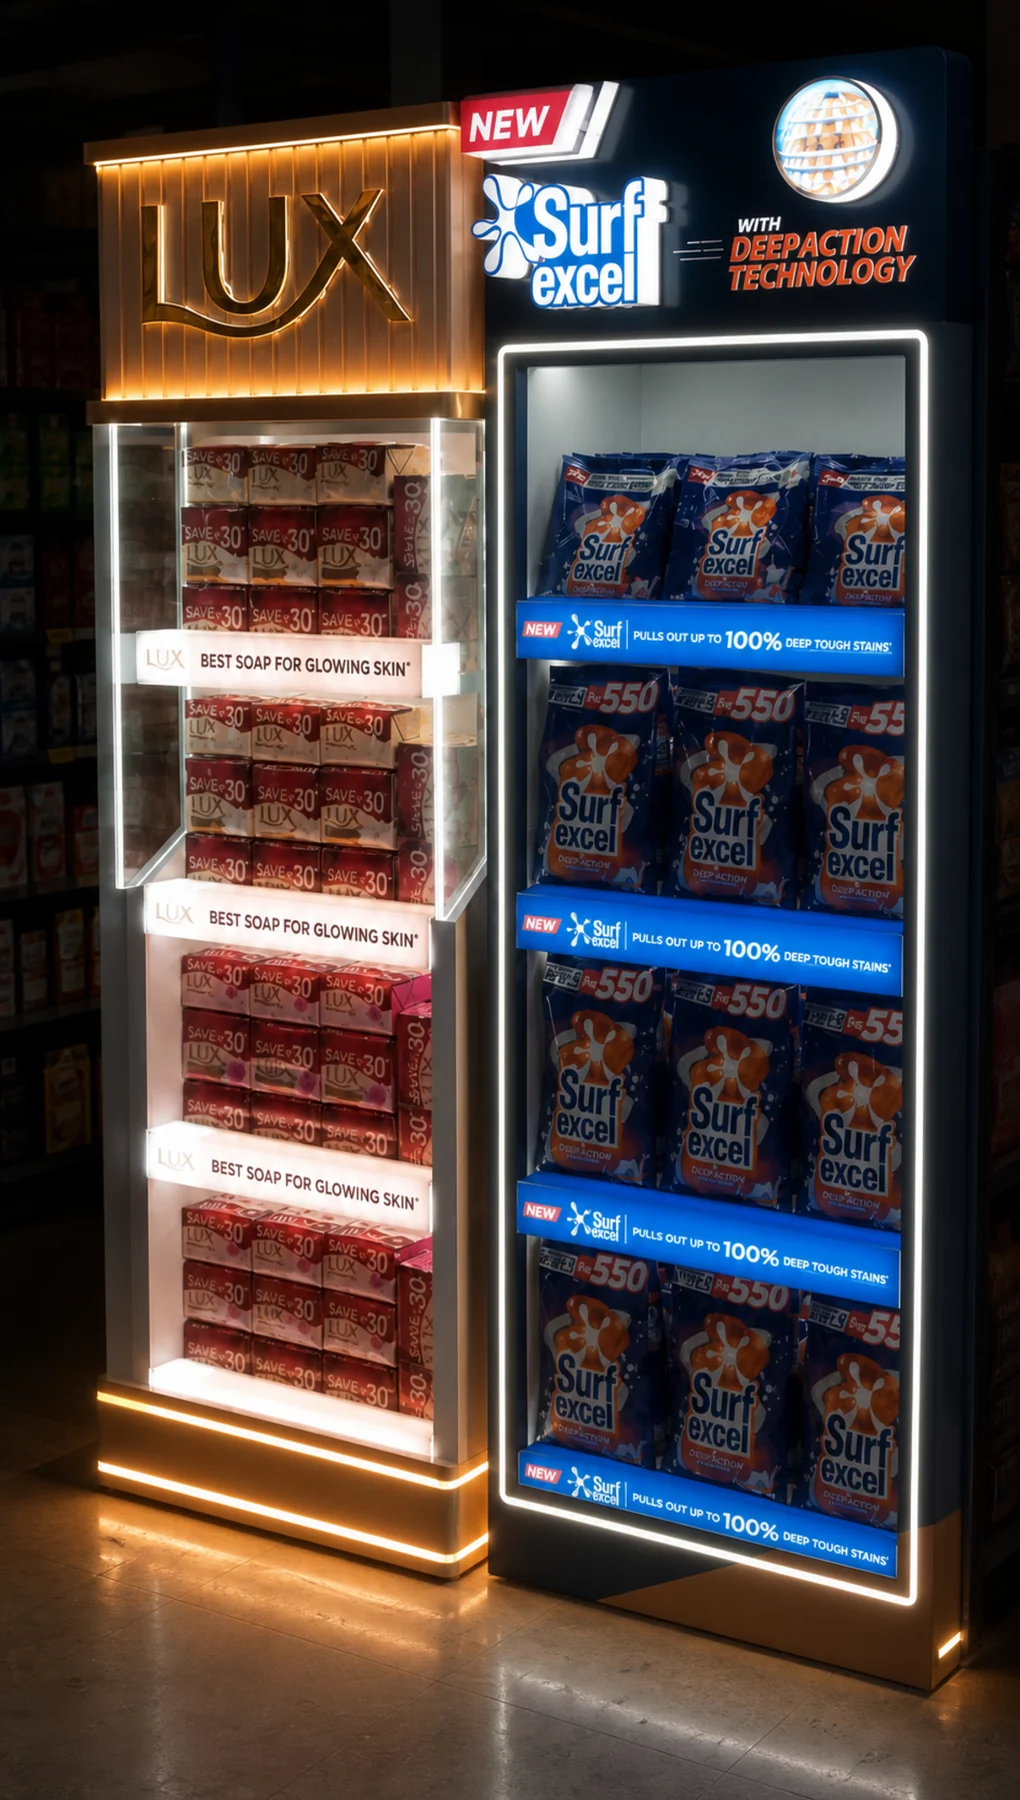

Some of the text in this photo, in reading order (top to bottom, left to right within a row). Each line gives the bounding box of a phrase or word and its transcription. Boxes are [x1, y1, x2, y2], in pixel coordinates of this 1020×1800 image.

[468, 104, 551, 143] NEW
[532, 177, 646, 259] Surf
[738, 216, 782, 234] WITH
[140, 188, 413, 339] LUX
[729, 255, 917, 291] TECHNOLOGY
[537, 254, 638, 307] excel
[185, 526, 213, 539] SAVE
[252, 528, 280, 543] SAVE
[322, 528, 352, 541] SAVE
[708, 529, 762, 556] Surf
[579, 533, 633, 563] Surf
[847, 535, 903, 567] Surf
[573, 557, 621, 581] excel
[703, 555, 753, 576] excel
[842, 563, 900, 589] excel
[185, 605, 215, 619] SAVE
[252, 608, 281, 623] SAVE
[322, 612, 352, 627] SAVE
[524, 623, 558, 637] NEW
[594, 620, 622, 640] Surf
[633, 630, 664, 642] PULLS
[666, 631, 689, 643] OUT
[691, 633, 706, 644] UP
[707, 633, 722, 644] TO
[725, 630, 783, 652] 100%
[785, 637, 812, 650] DEEP
[814, 639, 851, 651] TOUGH
[592, 636, 621, 649] excel
[146, 648, 186, 670] LUX
[200, 653, 232, 669] BEST
[236, 655, 271, 670] SOAP
[275, 656, 302, 672] FOR
[305, 658, 370, 676] GLOWING
[598, 682, 660, 713] 550
[729, 687, 796, 722] 550
[189, 703, 217, 717] SAVE
[256, 708, 285, 724] SAVE
[327, 708, 354, 724] SAVE
[864, 702, 904, 736] 55
[190, 778, 218, 792] SAVE
[258, 786, 287, 801] SAVE
[326, 788, 356, 803] SAVE
[560, 781, 624, 826] Surf
[693, 790, 760, 838] Surf
[555, 822, 616, 854] excel
[829, 806, 900, 853] Surf
[690, 834, 753, 867] excel
[189, 856, 218, 871] SAVE
[256, 863, 286, 879] SAVE
[827, 849, 895, 882] excel
[327, 868, 358, 884] SAVE
[155, 902, 194, 924] LUX
[209, 910, 241, 927] BEST
[244, 914, 280, 932] SOAP
[283, 919, 310, 935] FOR
[313, 923, 379, 944] GLOWING
[524, 917, 557, 932] NEW
[593, 920, 621, 939] Surf
[592, 934, 620, 949] excel
[632, 932, 663, 946] PULLS
[665, 935, 688, 948] OUT
[690, 938, 704, 950] UP
[705, 940, 721, 952] TO
[723, 939, 781, 963] 100%
[783, 950, 811, 963] DEEP
[812, 955, 850, 969] TOUGH
[187, 958, 215, 975] SAVE
[254, 967, 282, 984] SAVE
[326, 975, 356, 993] SAVE
[593, 966, 654, 1002] 550
[727, 982, 788, 1019] 550
[860, 1007, 902, 1045] 55
[325, 1049, 356, 1067] SAVE
[560, 1067, 623, 1118] Surf
[690, 1086, 758, 1136] Surf
[557, 1111, 616, 1145] excel
[823, 1112, 892, 1164] Surf
[687, 1128, 751, 1166] excel
[157, 1147, 196, 1171] LUX
[211, 1159, 244, 1178] BEST
[246, 1166, 282, 1186] SOAP
[285, 1173, 312, 1191] FOR
[315, 1179, 380, 1204] GLOWING
[820, 1157, 886, 1194] excel
[187, 1212, 215, 1229] SAVE
[525, 1205, 557, 1220] NEW
[592, 1211, 621, 1231] Surf
[256, 1224, 285, 1243] SAVE
[591, 1226, 619, 1243] excel
[328, 1239, 358, 1258] SAVE
[632, 1227, 663, 1242] PULLS
[665, 1232, 688, 1246] OUT
[689, 1237, 705, 1249] UP
[705, 1241, 721, 1252] TO
[722, 1240, 779, 1267] 100%
[783, 1256, 810, 1270] DEEP
[811, 1262, 849, 1278] TOUGH
[589, 1255, 648, 1293] 550
[328, 1303, 358, 1322] SAVE
[865, 1311, 901, 1349] 55
[187, 1342, 217, 1361] SAVE
[256, 1357, 286, 1375] SAVE
[327, 1374, 359, 1393] SAVE
[557, 1354, 617, 1404] Surf
[692, 1373, 757, 1423] Surf
[555, 1396, 614, 1429] excel
[688, 1416, 749, 1454] excel
[825, 1414, 892, 1468] Surf
[525, 1466, 558, 1483] NEW
[593, 1475, 621, 1495] Surf
[820, 1459, 886, 1497] excel
[592, 1489, 620, 1506] excel
[632, 1493, 663, 1509] PULLS
[665, 1501, 688, 1515] OUT
[689, 1506, 705, 1519] UP
[705, 1511, 721, 1523] TO
[722, 1512, 779, 1542] 100%
[783, 1531, 810, 1546] DEEP
[811, 1538, 849, 1556] TOUGH
